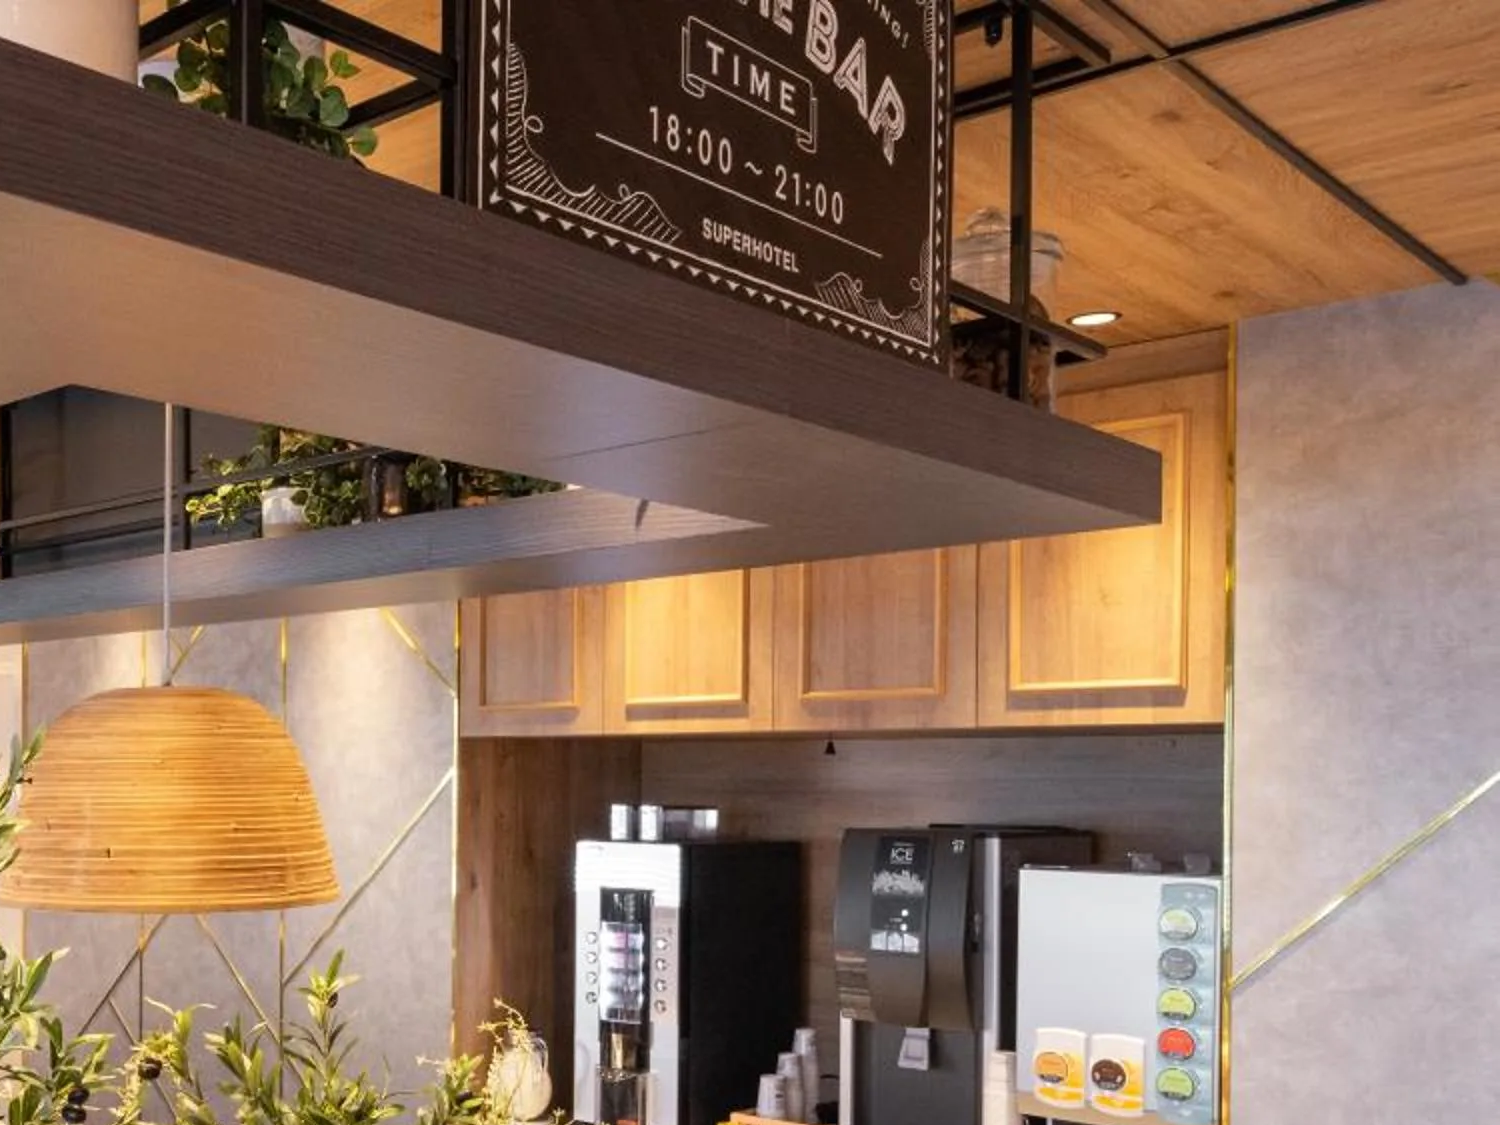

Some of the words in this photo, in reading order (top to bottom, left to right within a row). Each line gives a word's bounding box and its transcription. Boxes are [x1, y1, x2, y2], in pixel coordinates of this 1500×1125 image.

[705, 40, 797, 117] TIME
[805, 0, 906, 166] BAR
[649, 105, 733, 175] 18:00
[775, 164, 844, 225] 21:00
[702, 217, 800, 274] SUPERHOTEL
